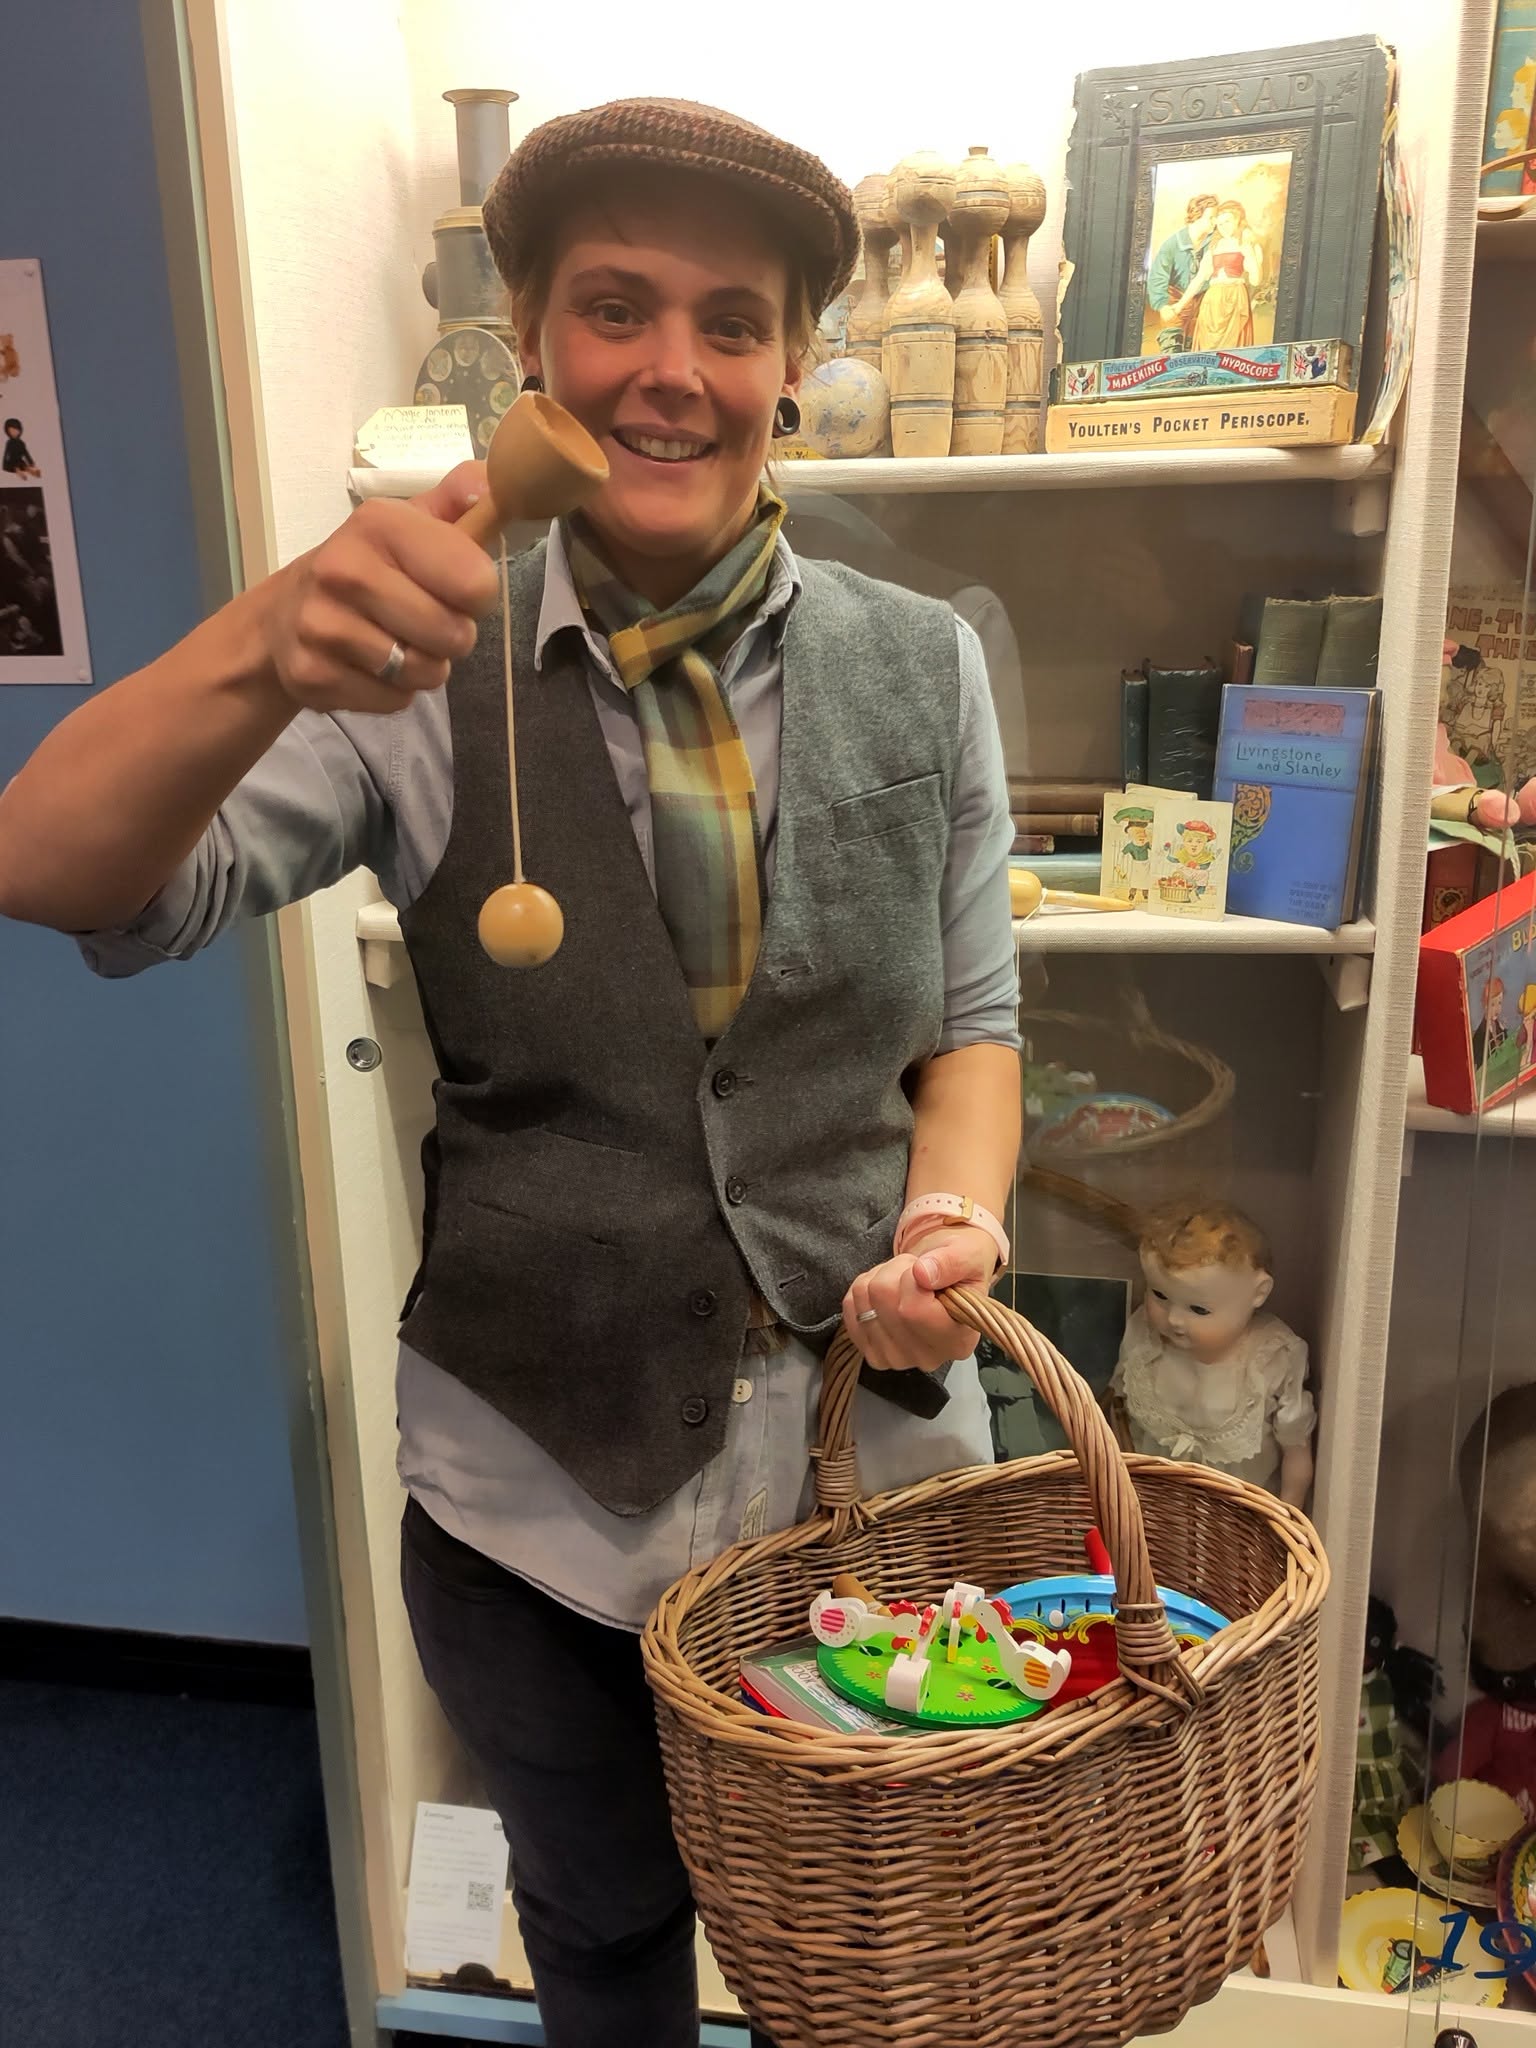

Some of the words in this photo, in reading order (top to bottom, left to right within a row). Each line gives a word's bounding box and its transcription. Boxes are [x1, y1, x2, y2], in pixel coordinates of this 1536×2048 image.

[1147, 72, 1314, 125] SCRAP
[1112, 361, 1162, 389] MAFEKING
[1169, 355, 1217, 369] OBSERVATION
[1068, 421, 1141, 438] YOULTEN'S
[1153, 416, 1209, 433] POCKET
[1220, 412, 1310, 430] PERISCOPE.
[1236, 741, 1323, 762] Livingstone
[1257, 761, 1280, 773] and
[1285, 760, 1342, 779] Stanley
